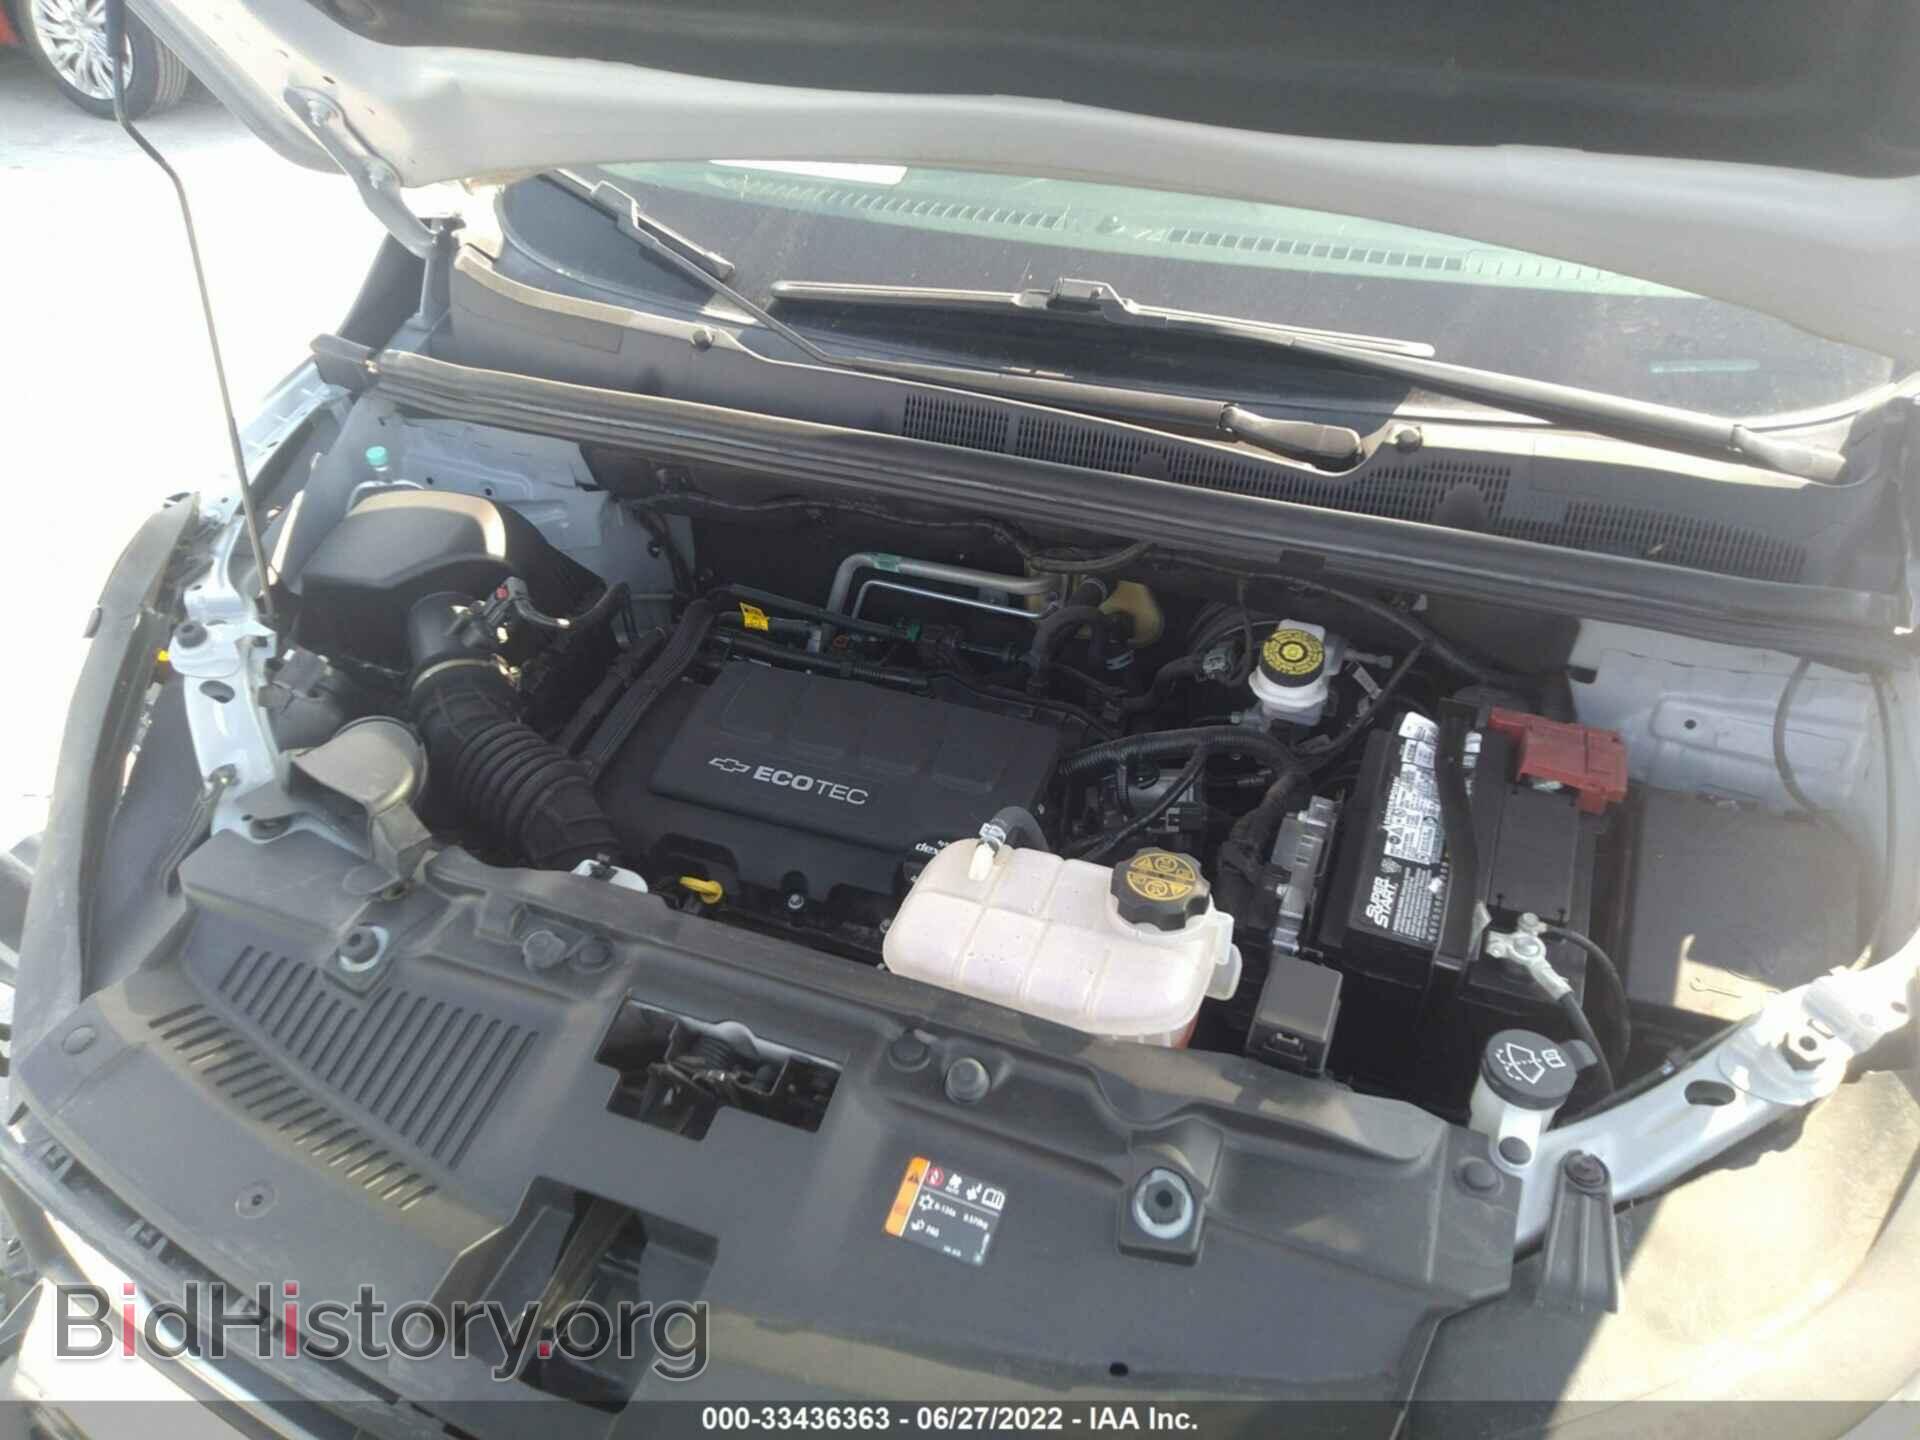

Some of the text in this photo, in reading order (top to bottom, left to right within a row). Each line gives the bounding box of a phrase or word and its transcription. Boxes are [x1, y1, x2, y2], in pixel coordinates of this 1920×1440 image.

[753, 765, 869, 805] ECOTEC
[1366, 876, 1389, 917] SUPER
[1374, 883, 1397, 929] START
